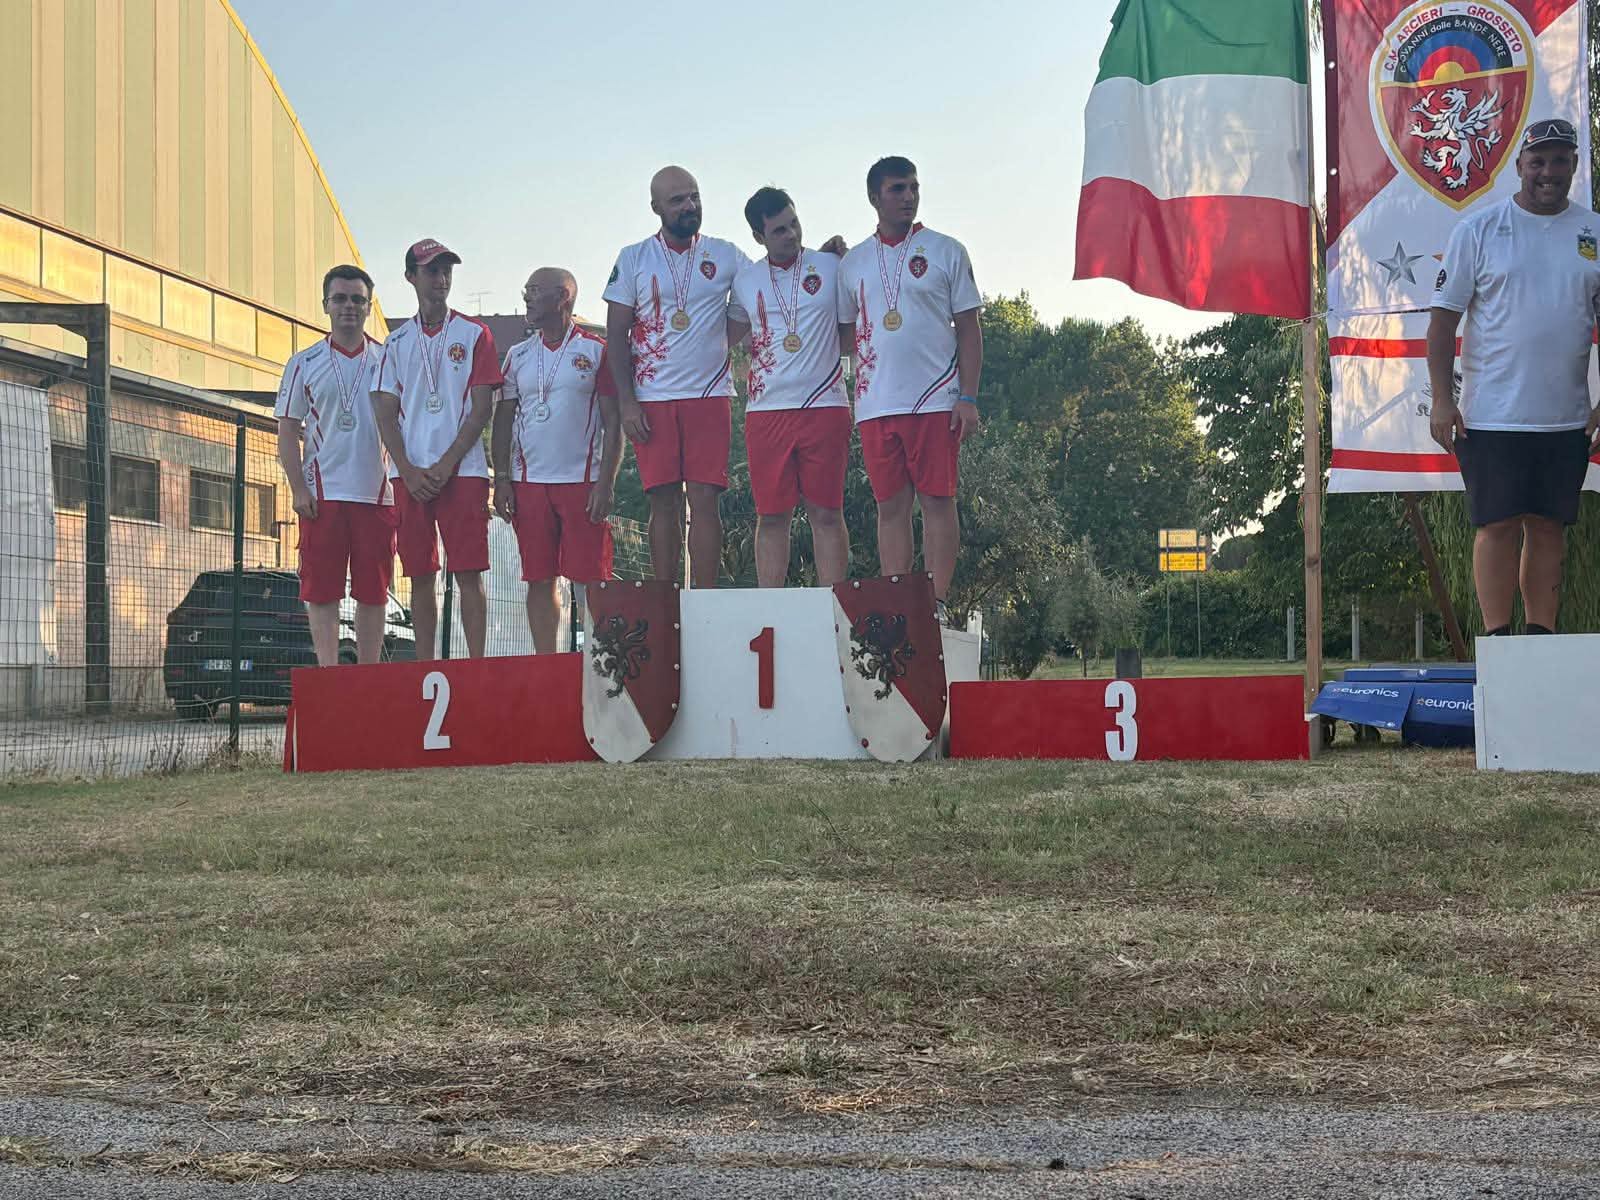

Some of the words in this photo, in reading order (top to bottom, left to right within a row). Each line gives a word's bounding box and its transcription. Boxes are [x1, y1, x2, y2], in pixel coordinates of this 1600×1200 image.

[1396, 7, 1443, 43] ARCIERI
[1467, 5, 1523, 53] GROSSETO
[1400, 30, 1428, 73] GOVANNI
[1454, 19, 1489, 36] BANDE
[1488, 33, 1507, 57] NERE
[749, 626, 774, 709] 1
[1340, 686, 1400, 698] euronics
[422, 671, 451, 750] 2
[1104, 680, 1138, 762] 3
[1424, 698, 1475, 711] euronic
